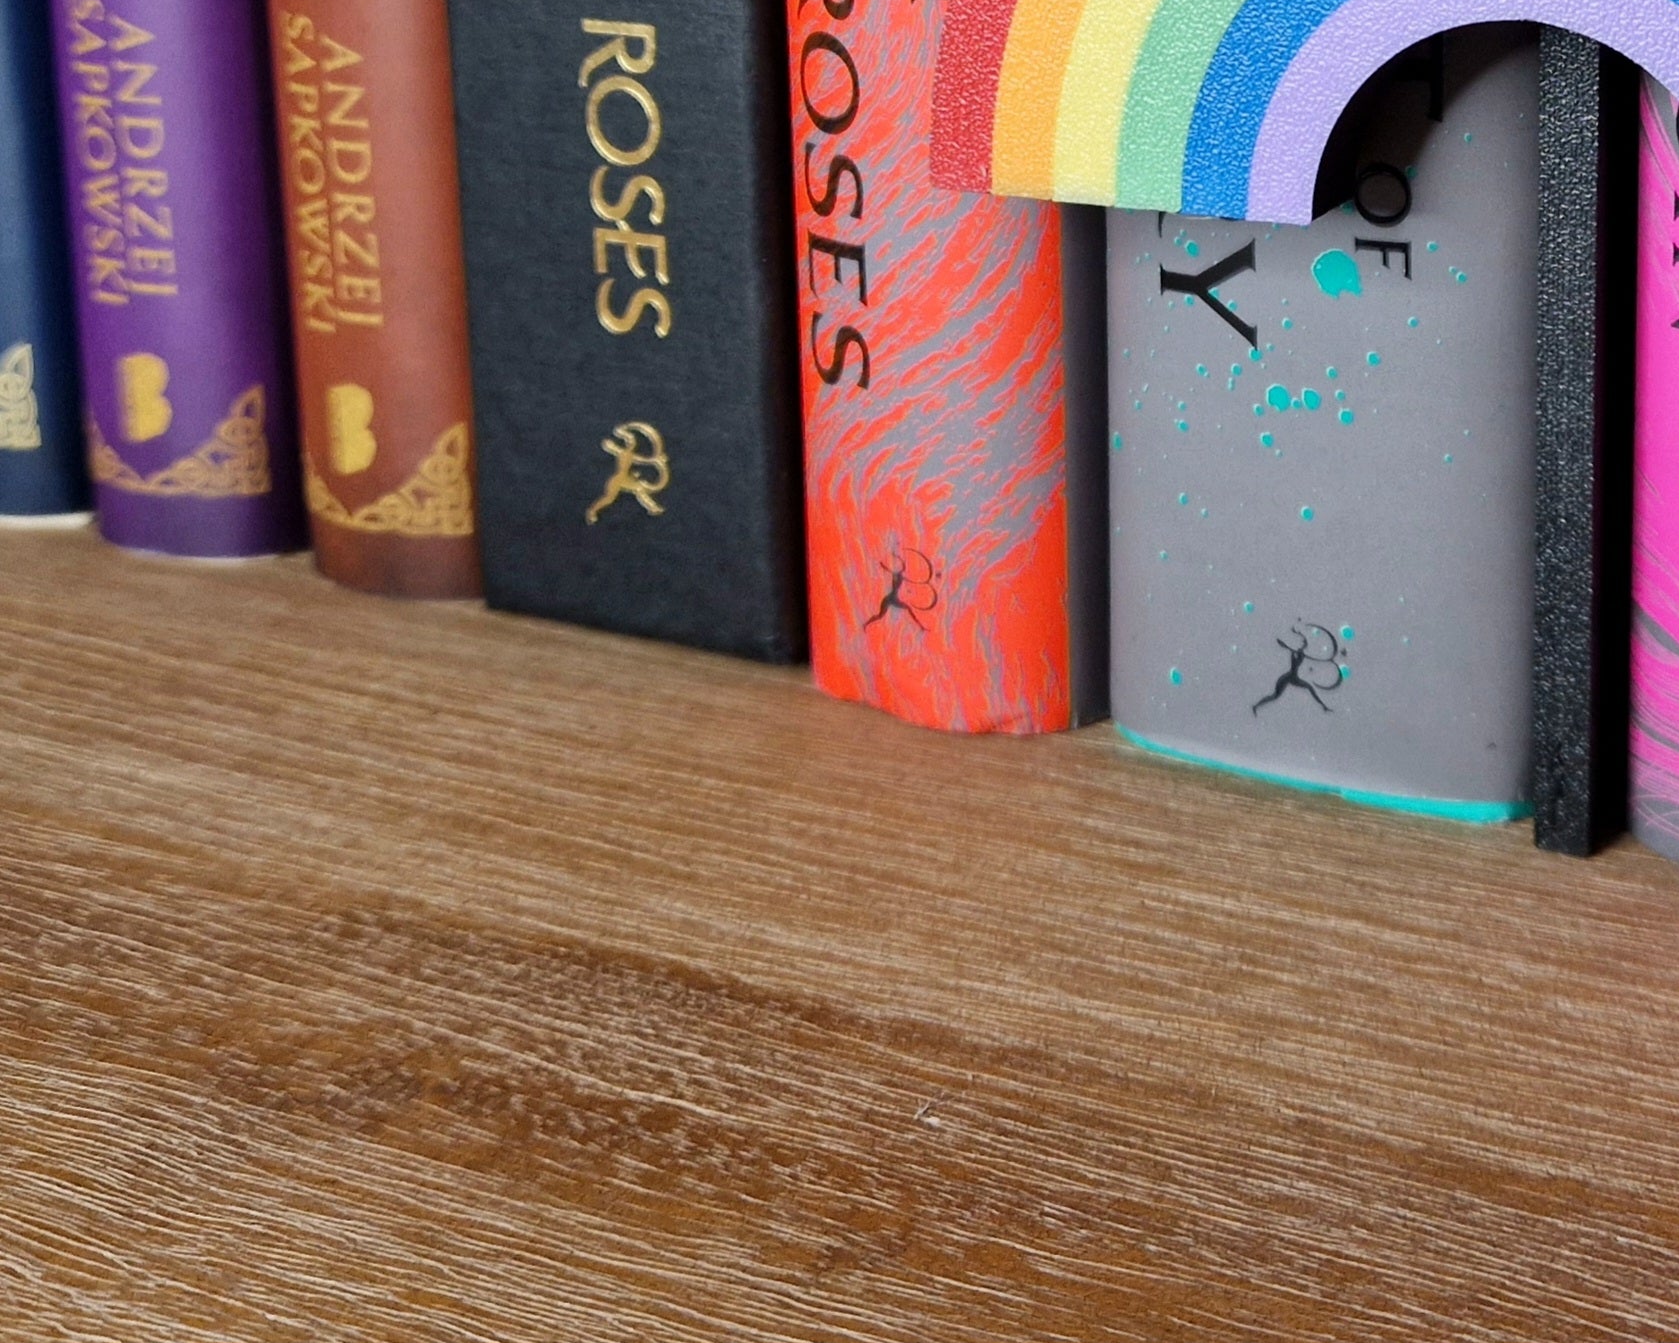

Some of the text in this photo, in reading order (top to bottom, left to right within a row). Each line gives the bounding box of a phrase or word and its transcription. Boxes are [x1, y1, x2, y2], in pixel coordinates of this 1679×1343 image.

[104, 11, 178, 297] ANDRZEJ
[280, 11, 335, 333] SAPKOWSKI
[318, 33, 384, 328] ANDRZEJ
[578, 17, 672, 338] ROSES
[1353, 161, 1412, 280] OF
